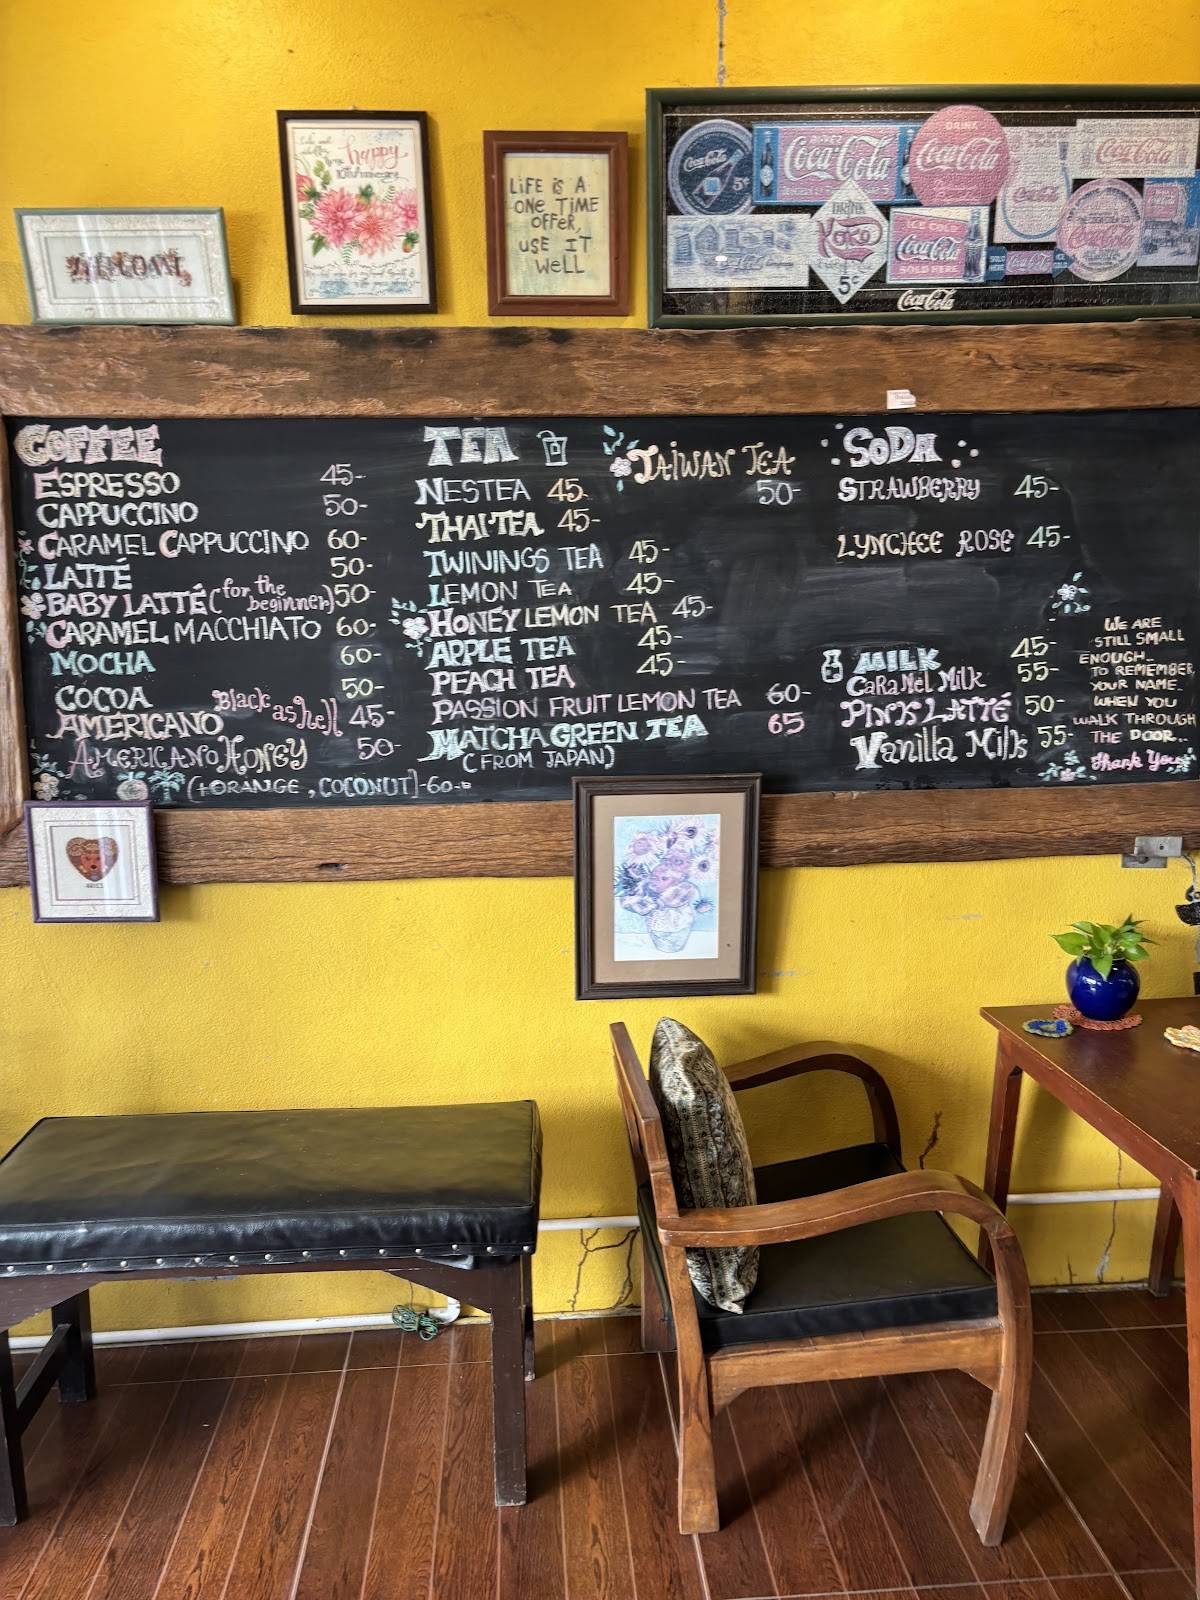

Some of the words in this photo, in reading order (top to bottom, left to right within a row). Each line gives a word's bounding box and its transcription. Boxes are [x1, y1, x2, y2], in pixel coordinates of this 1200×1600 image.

[574, 175, 586, 193] A
[565, 235, 592, 253] IT
[13, 423, 163, 467] COFFEE
[424, 425, 519, 466] TEA
[34, 467, 181, 500] ESPRESSO
[415, 478, 531, 506] NESTEA
[36, 501, 199, 529] CAPPUCCINO
[416, 510, 489, 544] THAI
[488, 509, 545, 537] TEA
[37, 531, 157, 561] CARAMEL
[159, 529, 310, 559] CAPPUCCINO
[423, 545, 550, 578] TWININGS
[558, 543, 604, 570] TEA
[253, 574, 287, 596] the
[427, 580, 518, 608] LEMON
[532, 580, 573, 598] TEA
[45, 590, 117, 619] BABY
[45, 617, 169, 650] CARAMEL
[174, 615, 322, 644] MACCHIATO
[426, 603, 524, 638] HONEY
[524, 603, 600, 628] LEMON
[610, 601, 658, 625] TEA
[1131, 616, 1162, 630] ARE
[1094, 634, 1131, 647] STILL
[1136, 629, 1185, 646] SMALL
[50, 650, 156, 677] MOCHA
[424, 638, 513, 671] APPLE
[520, 635, 576, 660] TEA
[853, 647, 943, 675] MILK
[429, 664, 517, 697] PEACH
[525, 664, 576, 690] TEA
[1090, 666, 1109, 678] TO
[1090, 679, 1128, 692] YOUR
[55, 684, 153, 713] COCOA
[431, 696, 538, 726] PASSION
[549, 693, 612, 719] FRUIT
[618, 687, 695, 714] LEMON
[702, 688, 742, 711] TEA
[1093, 694, 1139, 708] WHEN
[1145, 696, 1178, 709] YOU
[45, 709, 225, 742] AMERICANO
[272, 703, 297, 724] as
[293, 695, 343, 738] hell
[1072, 713, 1118, 726] WALK
[1122, 712, 1197, 728] THROUGH
[417, 725, 549, 763] MATCHA
[550, 721, 638, 748] GREEN
[645, 713, 710, 743] TEA
[767, 712, 806, 736] 65
[850, 724, 957, 771] Vanilla
[1090, 730, 1122, 744] THE
[63, 737, 220, 781] AMERICANO
[463, 750, 532, 774] (FROM
[546, 744, 615, 771] JAPAN)
